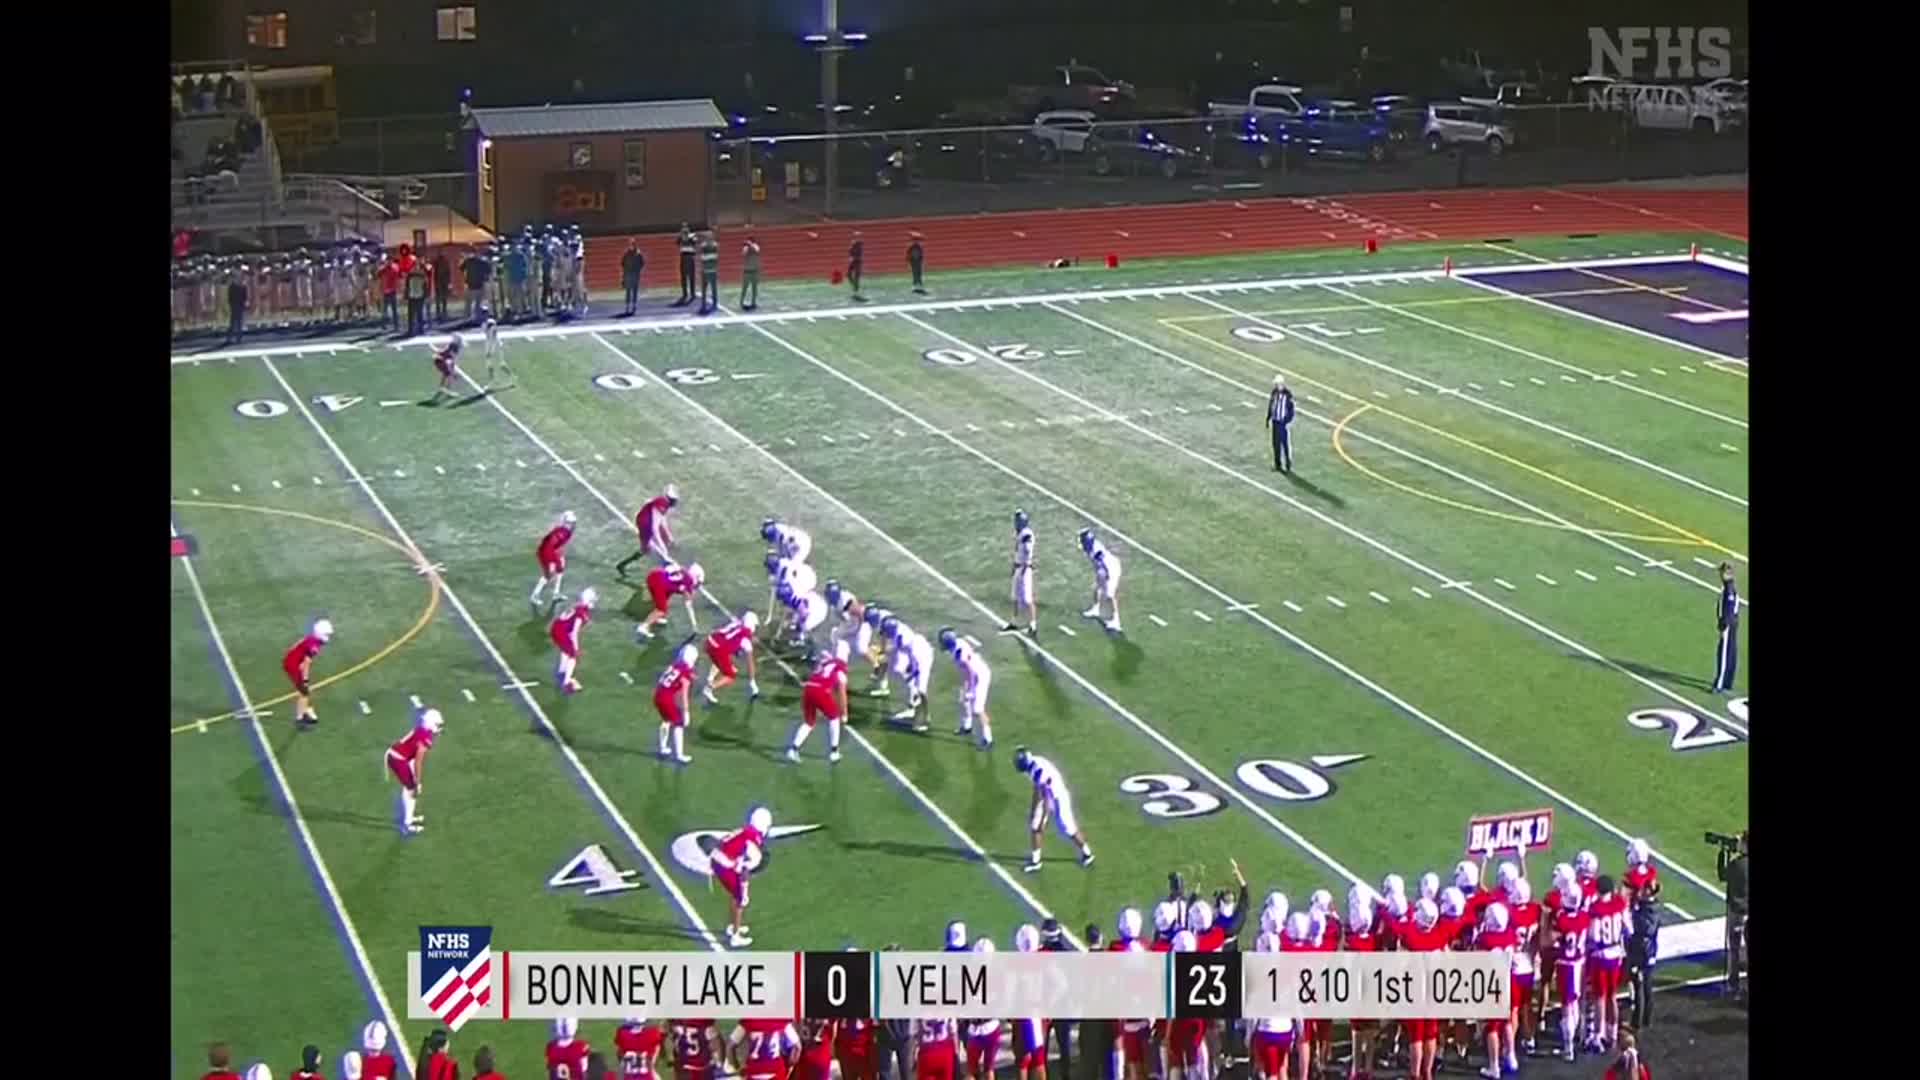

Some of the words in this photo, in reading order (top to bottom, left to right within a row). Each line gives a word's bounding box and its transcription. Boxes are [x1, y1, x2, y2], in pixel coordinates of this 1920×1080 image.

[1119, 759, 1330, 818] 30
[1471, 817, 1533, 851] BLACK
[1535, 815, 1550, 843] D
